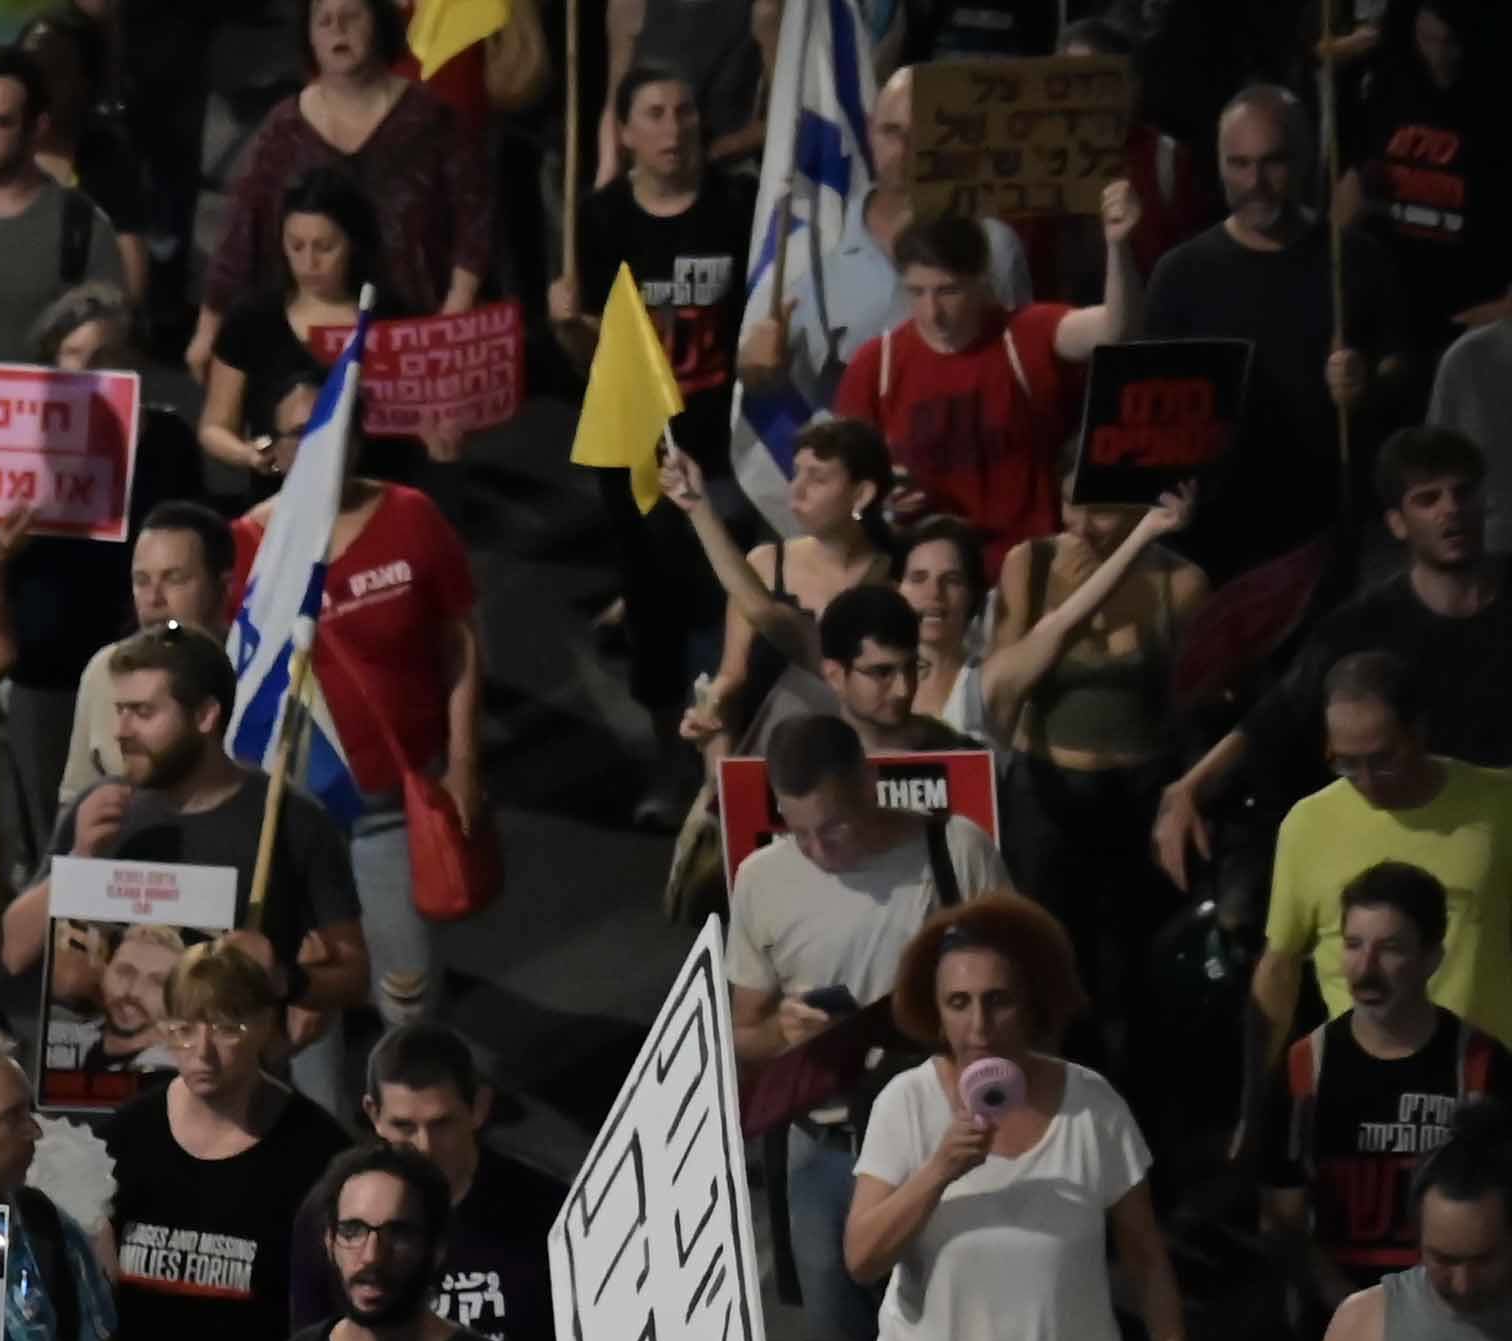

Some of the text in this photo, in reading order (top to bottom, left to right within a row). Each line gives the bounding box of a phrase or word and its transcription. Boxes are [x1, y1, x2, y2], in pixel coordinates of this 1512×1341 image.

[54, 470, 99, 506] או
[875, 777, 949, 809] THEM
[184, 1251, 253, 1294] FORUM
